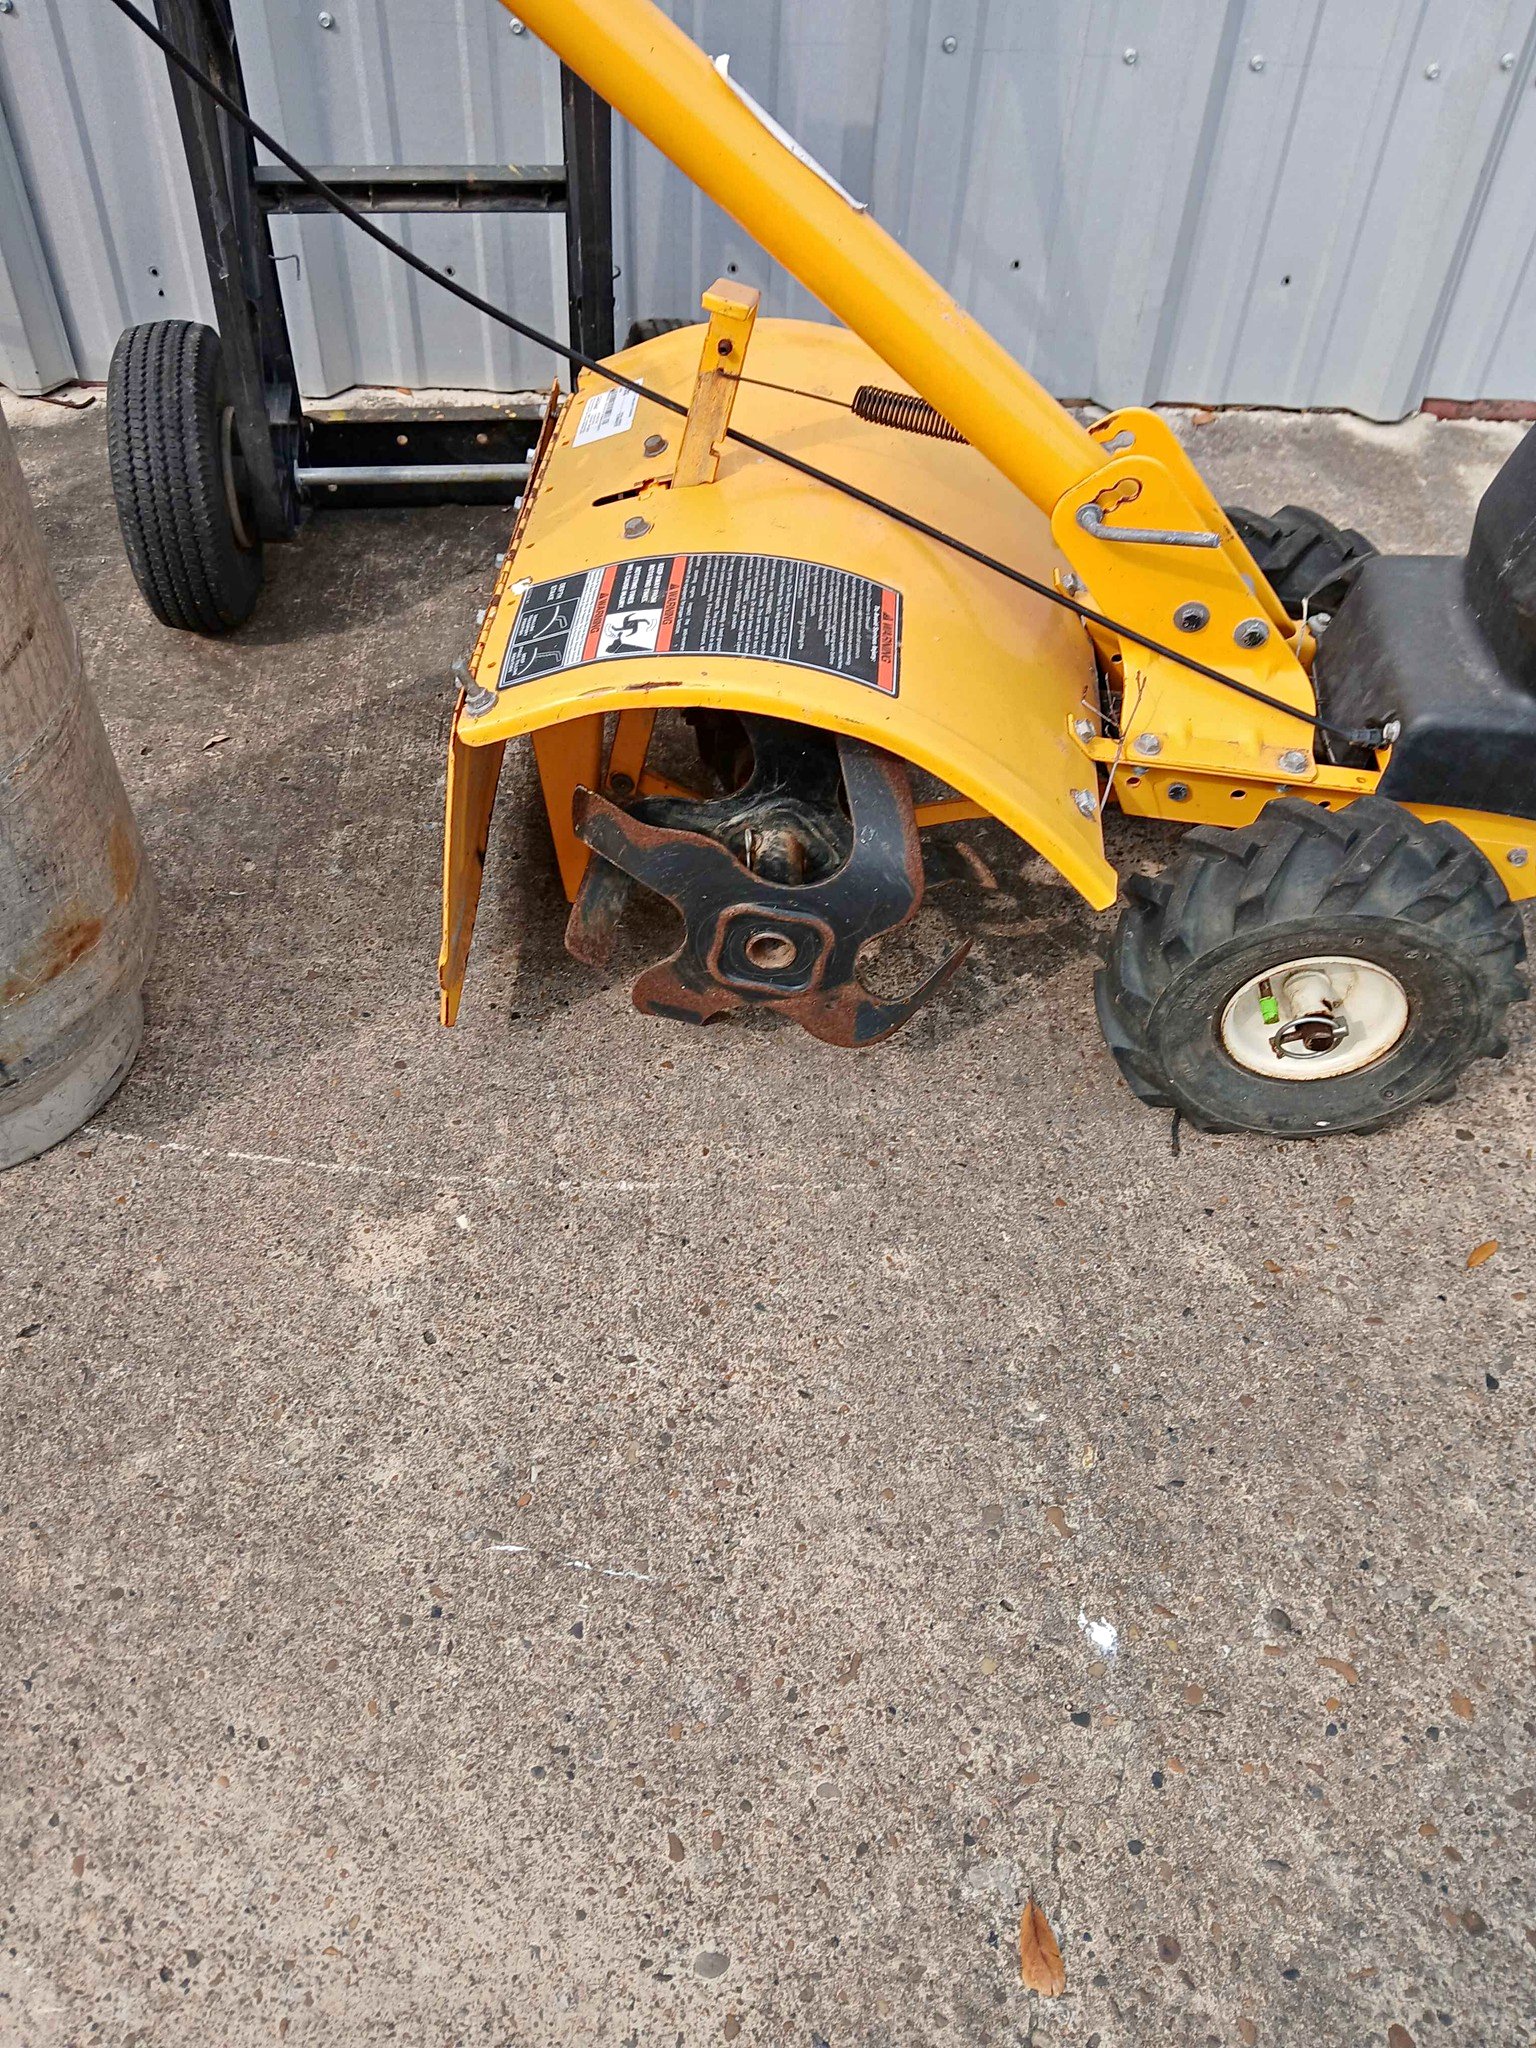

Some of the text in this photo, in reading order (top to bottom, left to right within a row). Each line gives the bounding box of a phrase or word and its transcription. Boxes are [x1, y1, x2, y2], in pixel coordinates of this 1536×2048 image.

[655, 562, 665, 575] KEEP
[590, 598, 607, 633] WARNING
[662, 590, 678, 624] WARNING
[880, 621, 892, 664] WARNING
